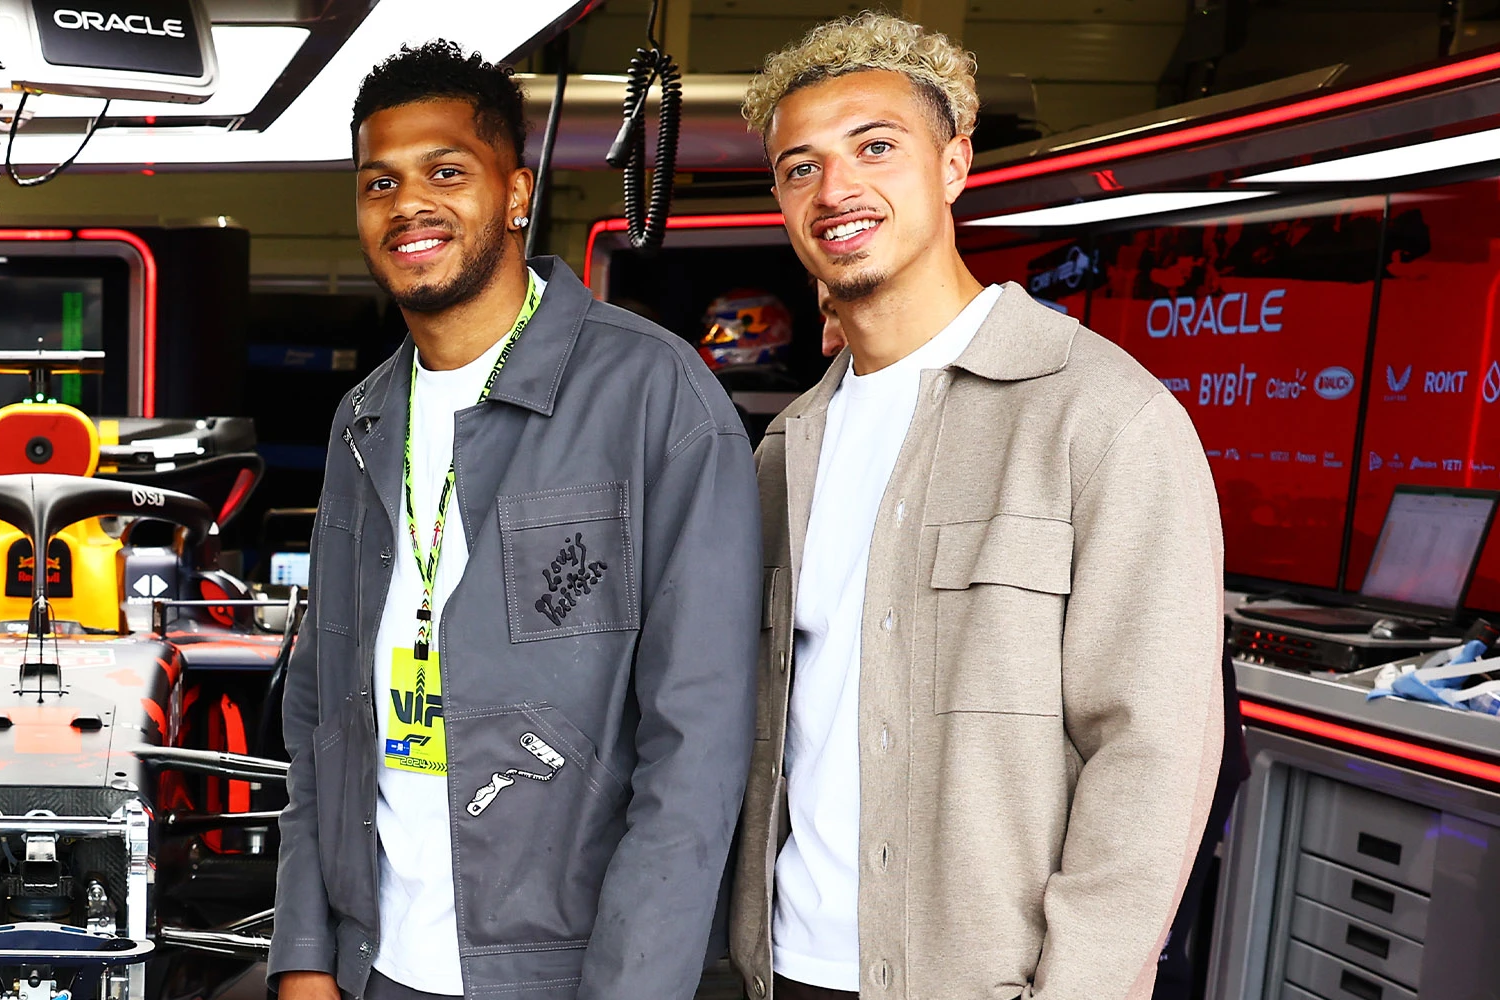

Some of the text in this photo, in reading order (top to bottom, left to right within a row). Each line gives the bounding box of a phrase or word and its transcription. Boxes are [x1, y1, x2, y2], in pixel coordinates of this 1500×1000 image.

[53, 8, 185, 39] ORACLE
[1147, 289, 1286, 338] ORACLE
[1198, 363, 1257, 406] BYBIT
[1266, 376, 1301, 399] Claro
[1424, 371, 1468, 393] ROKT
[1442, 459, 1462, 471] YETI
[390, 688, 444, 728] VIP
[400, 757, 427, 769] 2024
